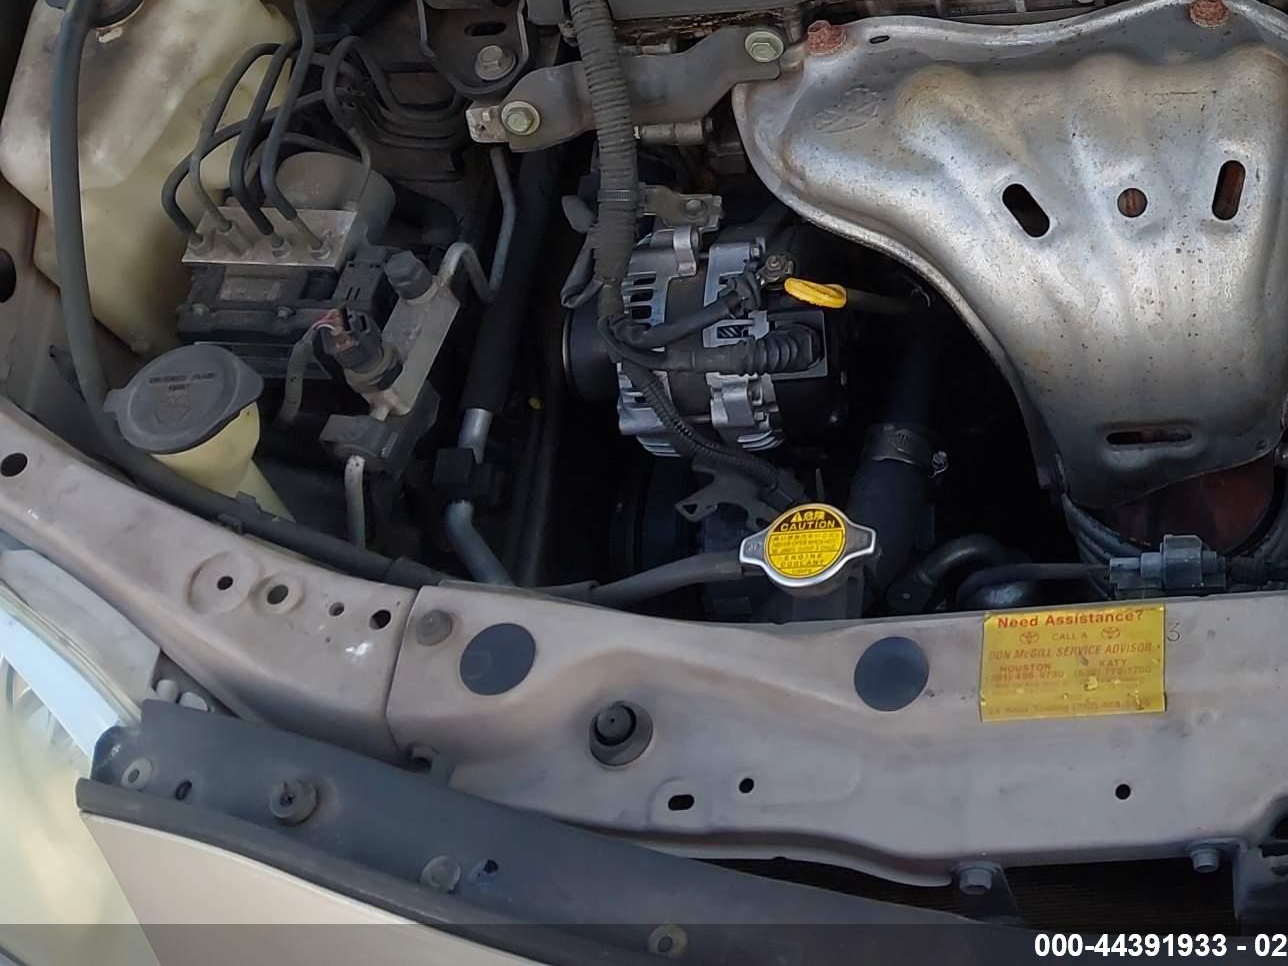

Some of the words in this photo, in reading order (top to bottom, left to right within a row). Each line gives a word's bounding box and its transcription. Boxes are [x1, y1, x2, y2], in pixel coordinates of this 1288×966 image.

[780, 520, 835, 531] CAUTION
[997, 617, 1038, 628] Need
[1045, 610, 1143, 626] Assistance?
[1052, 633, 1076, 641] CALL
[1081, 632, 1088, 640] A
[1013, 648, 1051, 659] McGILL
[1056, 645, 1101, 657] SERVICE
[1104, 642, 1152, 653] ADVISOR
[1100, 659, 1128, 667] KATY
[999, 664, 1051, 674] HOUSTON
